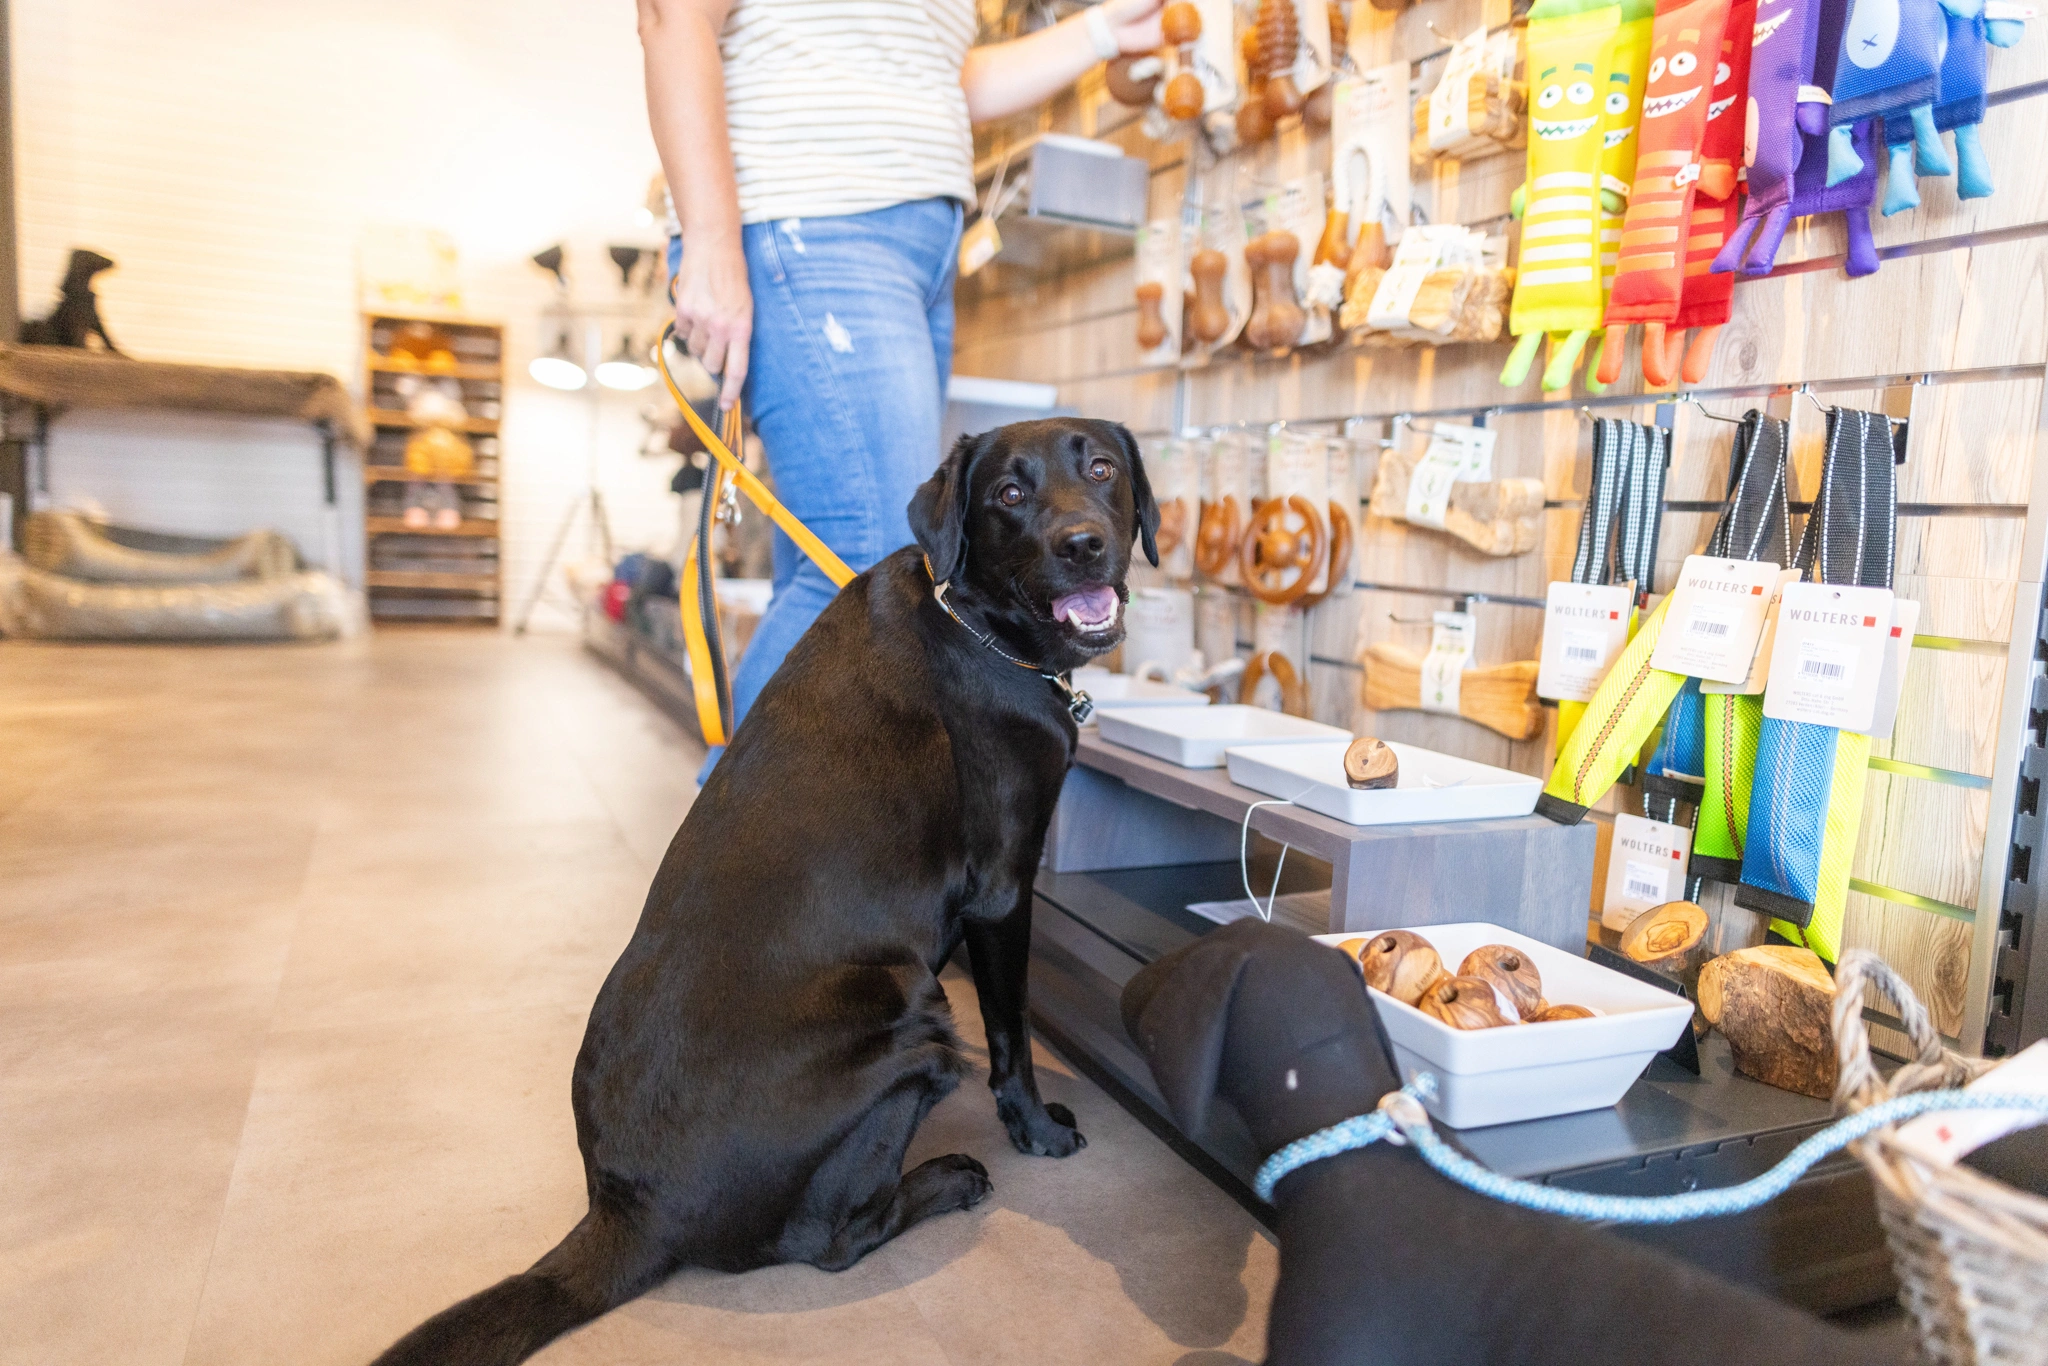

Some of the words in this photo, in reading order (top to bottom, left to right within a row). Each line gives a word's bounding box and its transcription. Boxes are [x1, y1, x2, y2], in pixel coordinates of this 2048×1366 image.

[1688, 578, 1748, 594] WOLTERS
[1555, 605, 1606, 620] WOLTERS
[1790, 609, 1858, 626] WOLTERS
[1621, 837, 1669, 857] WOLTERS
